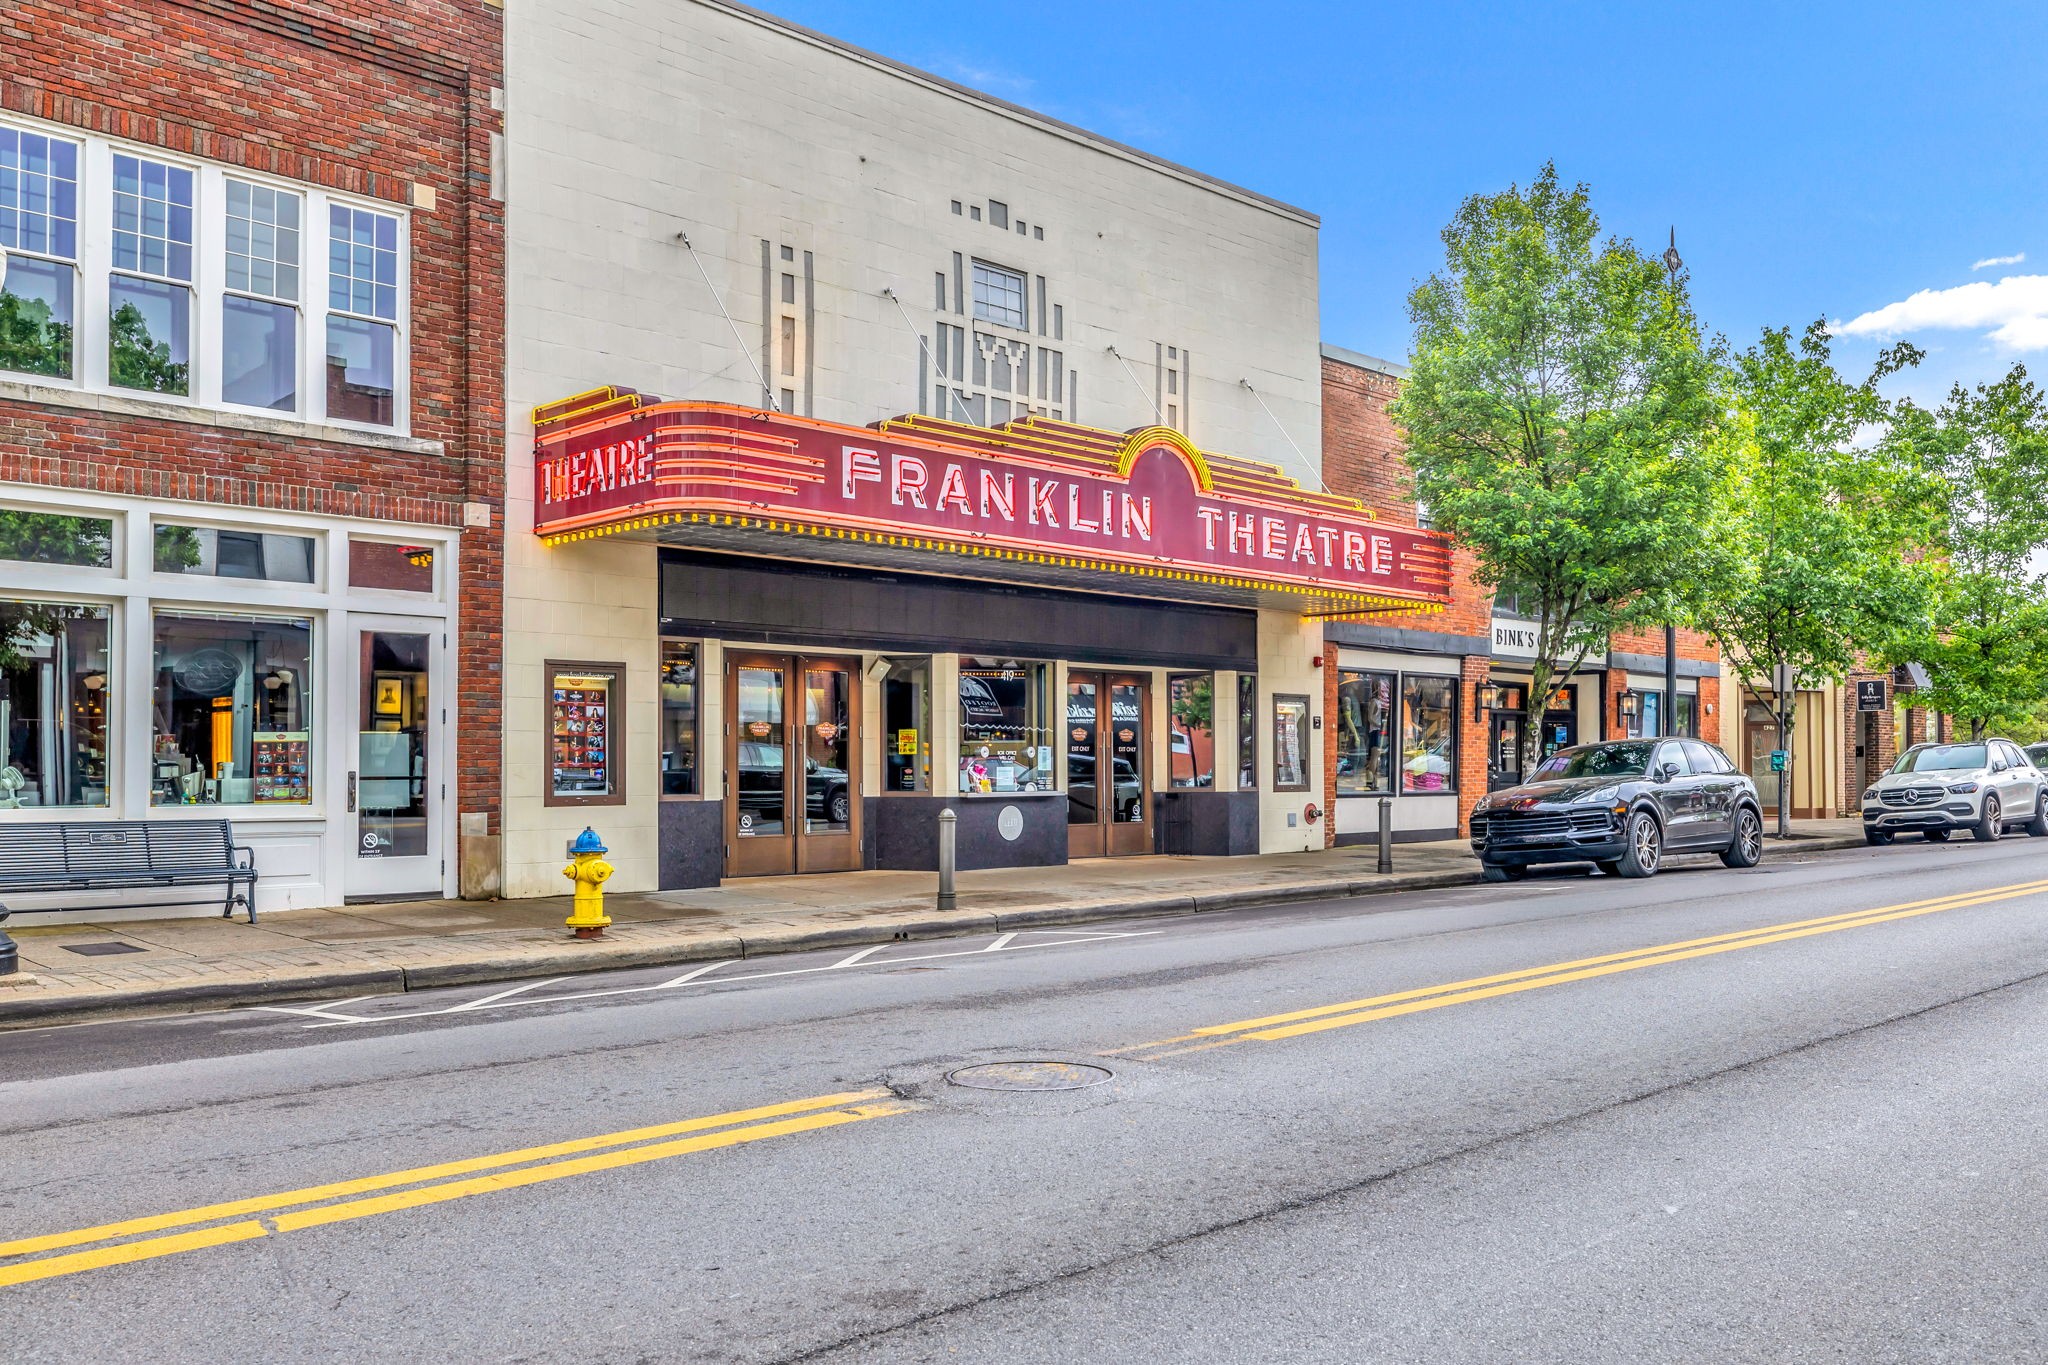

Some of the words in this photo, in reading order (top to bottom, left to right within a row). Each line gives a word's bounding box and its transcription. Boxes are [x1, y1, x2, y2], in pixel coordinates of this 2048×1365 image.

[537, 434, 653, 505] THEATRE
[842, 446, 1151, 541] FRANKLIN
[1197, 506, 1393, 575] THEATRE
[1496, 628, 1534, 648] BINK'S
[1001, 670, 1014, 681] 419
